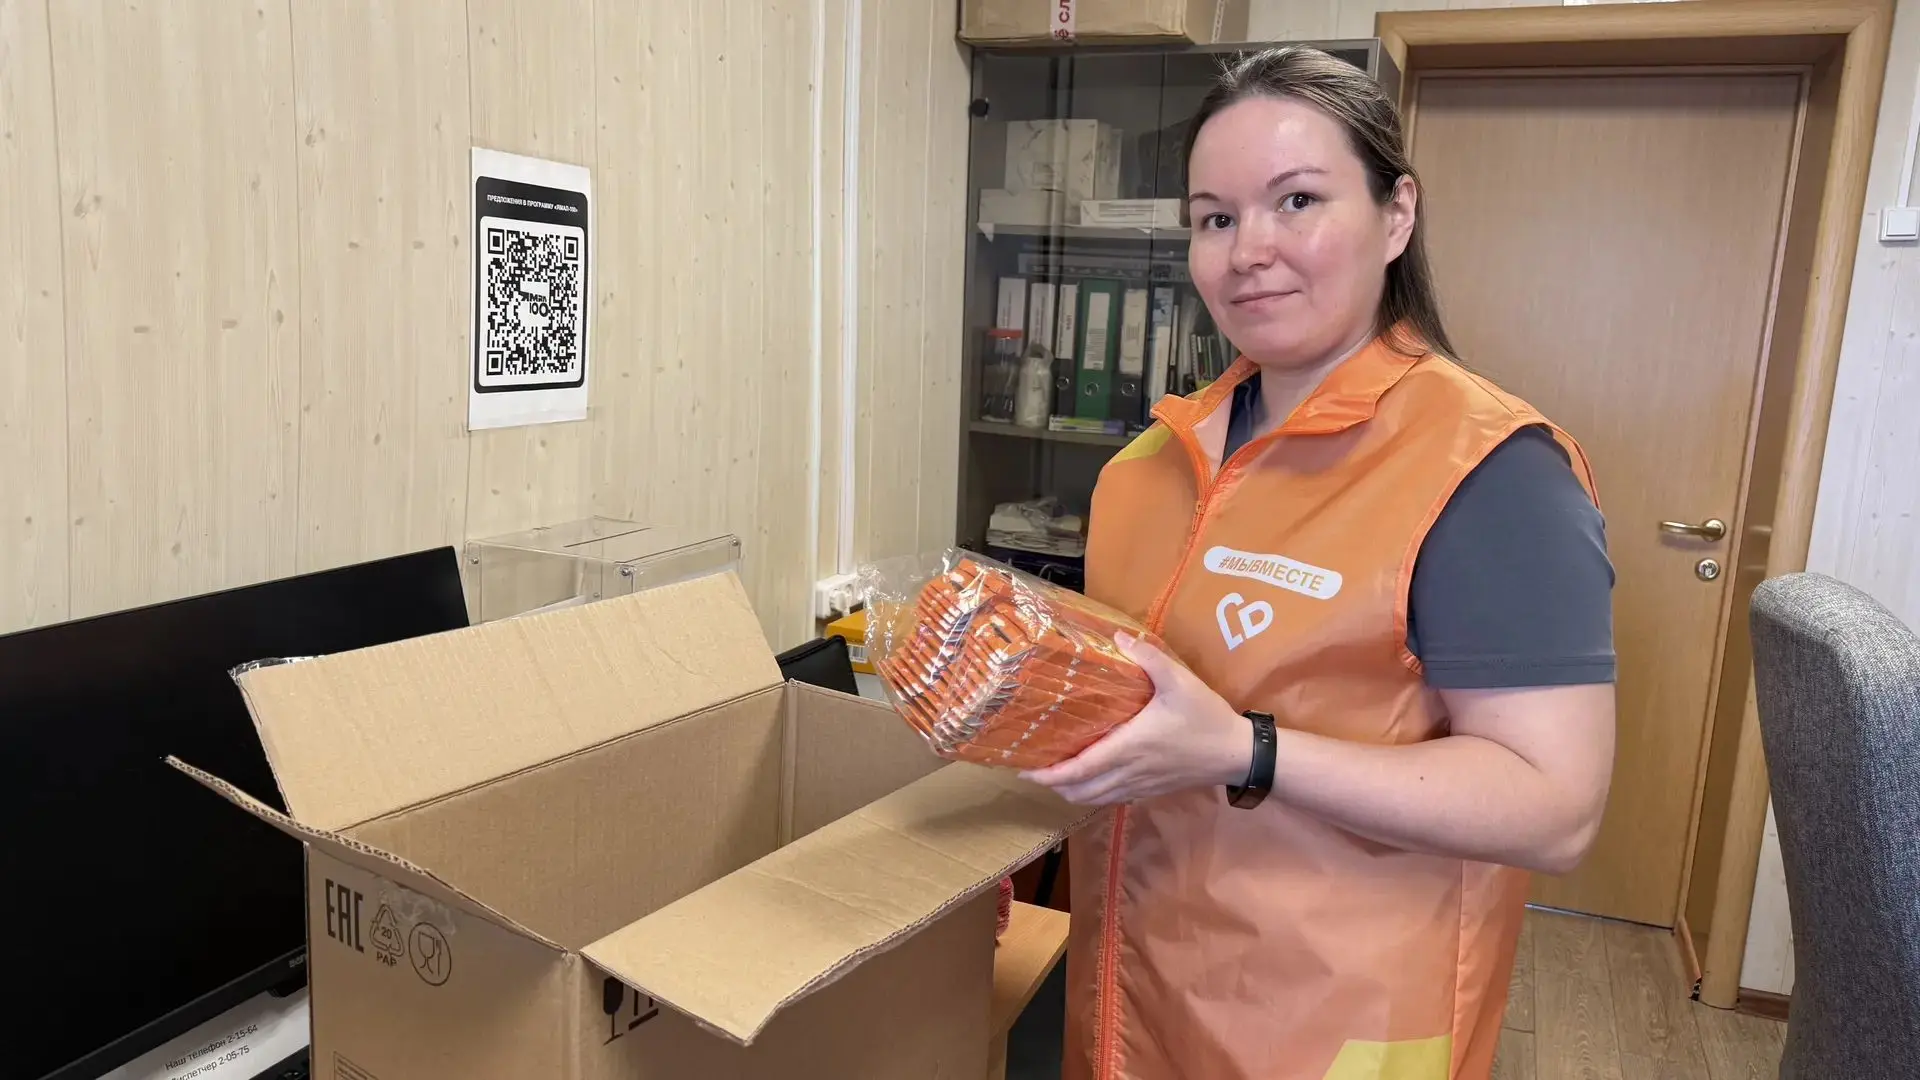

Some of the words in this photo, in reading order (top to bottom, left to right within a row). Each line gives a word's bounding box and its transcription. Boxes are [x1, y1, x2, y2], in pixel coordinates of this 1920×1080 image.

[487, 194, 522, 206] ПРЕДЛОЖЕНИЯ
[527, 200, 554, 210] ПРОГРАММУ
[529, 302, 549, 317] 100
[1218, 556, 1324, 591] #МЫВМЕСТЕ
[325, 878, 364, 953] EAC
[381, 926, 392, 939] 20
[376, 951, 397, 967] PAP
[166, 1057, 187, 1070] Наш
[188, 1039, 226, 1061] телефон
[227, 1024, 258, 1043] 2-15-64
[171, 1061, 217, 1080] испетчер
[218, 1044, 250, 1065] 2-05-75
